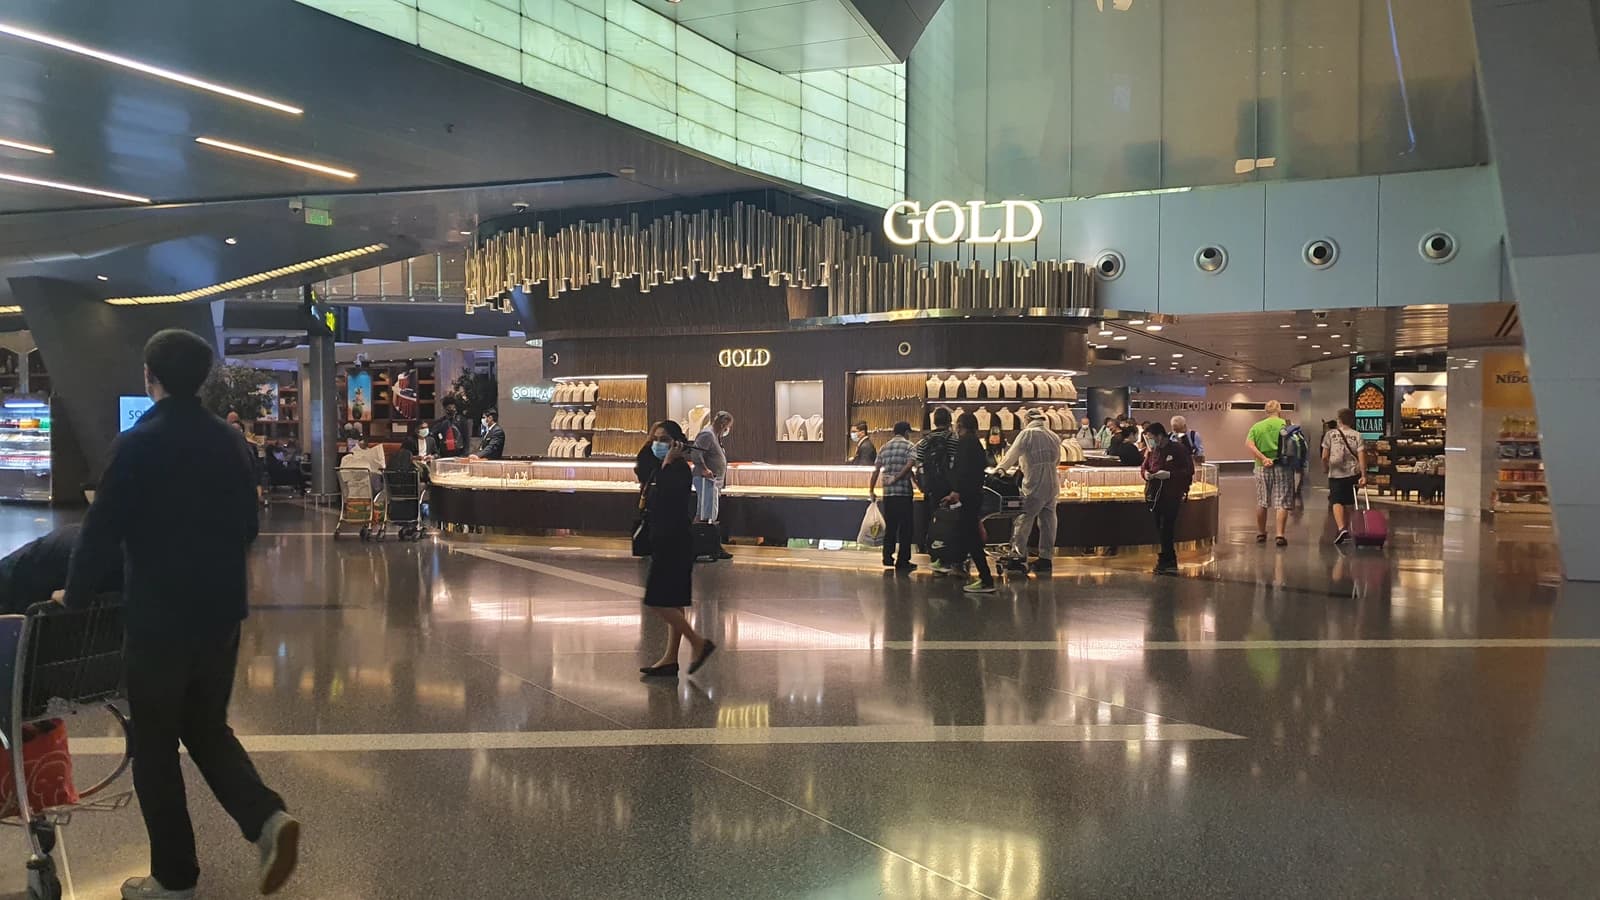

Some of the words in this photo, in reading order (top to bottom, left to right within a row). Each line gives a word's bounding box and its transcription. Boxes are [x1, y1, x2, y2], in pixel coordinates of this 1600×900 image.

[883, 199, 1042, 245] GOLD
[718, 348, 770, 367] GOLD
[512, 386, 555, 400] SOA
[1187, 401, 1232, 412] COMPTOIR
[1355, 418, 1383, 431] BAZAAR
